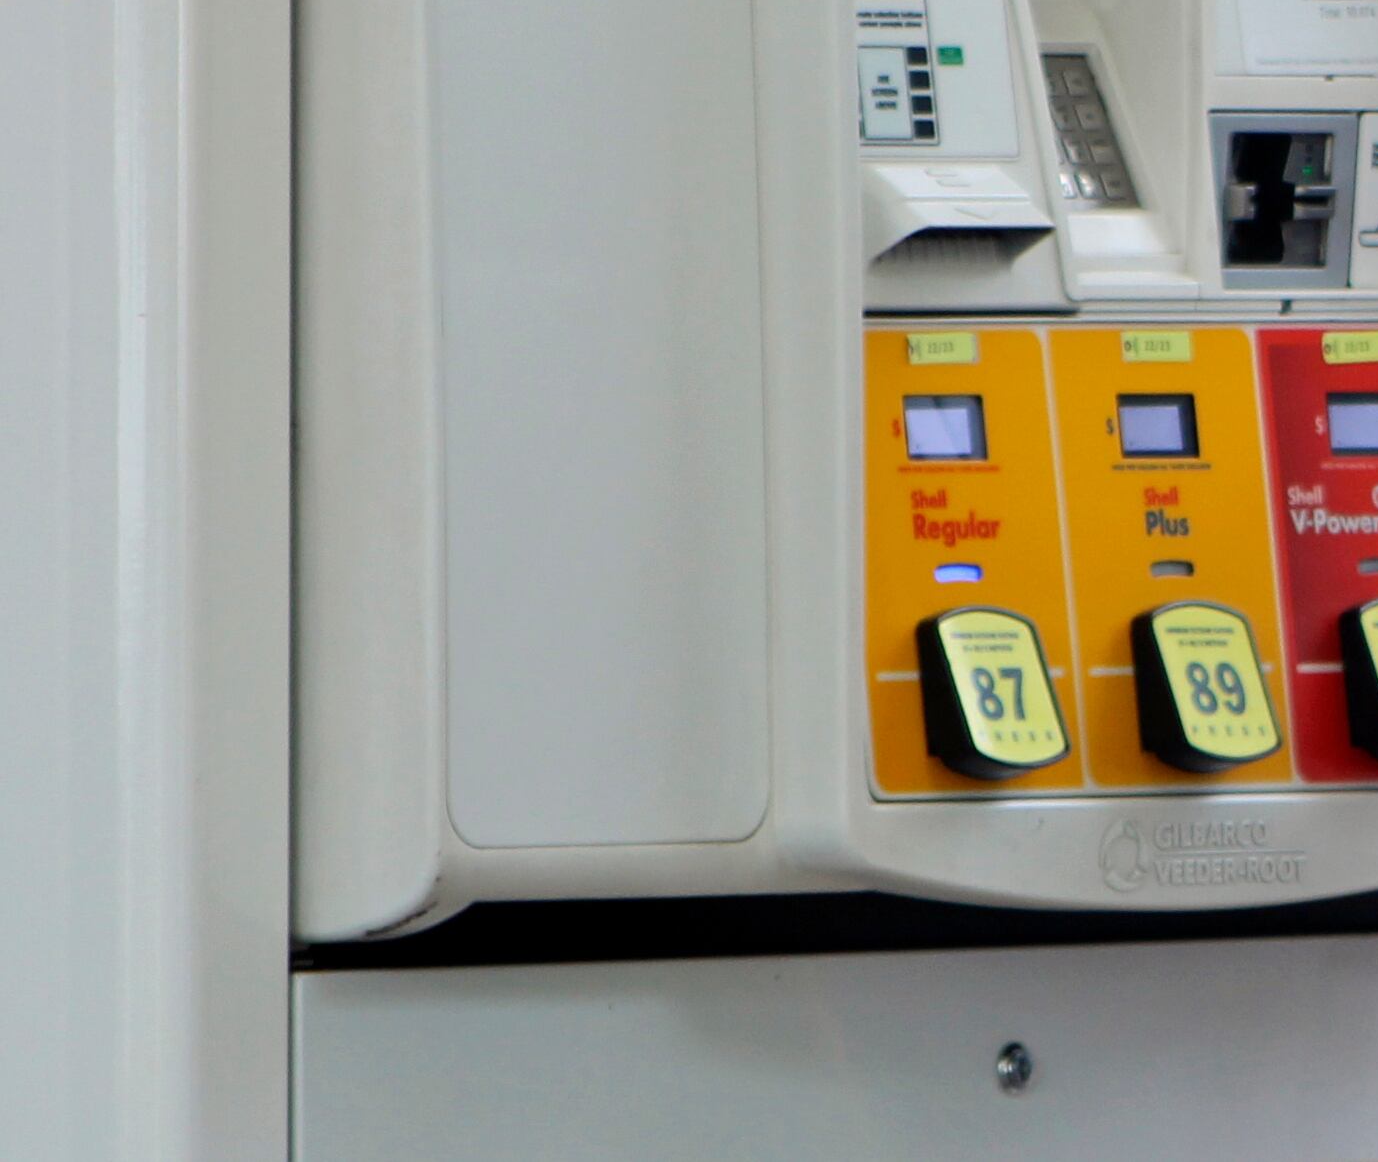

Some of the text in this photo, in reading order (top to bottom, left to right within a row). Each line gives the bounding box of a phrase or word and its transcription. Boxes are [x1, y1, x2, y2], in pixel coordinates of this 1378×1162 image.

[1106, 417, 1115, 435] $
[1315, 415, 1326, 435] $
[911, 489, 947, 510] Shell
[1143, 486, 1178, 507] Shell
[1287, 484, 1323, 506] Shell
[912, 509, 1000, 548] Regular
[1145, 508, 1190, 537] Plus
[970, 666, 1027, 722] 87
[1185, 661, 1247, 716] 89
[1152, 820, 1267, 851] GILBARCO
[1152, 855, 1307, 887] VEEDER-ROOT
